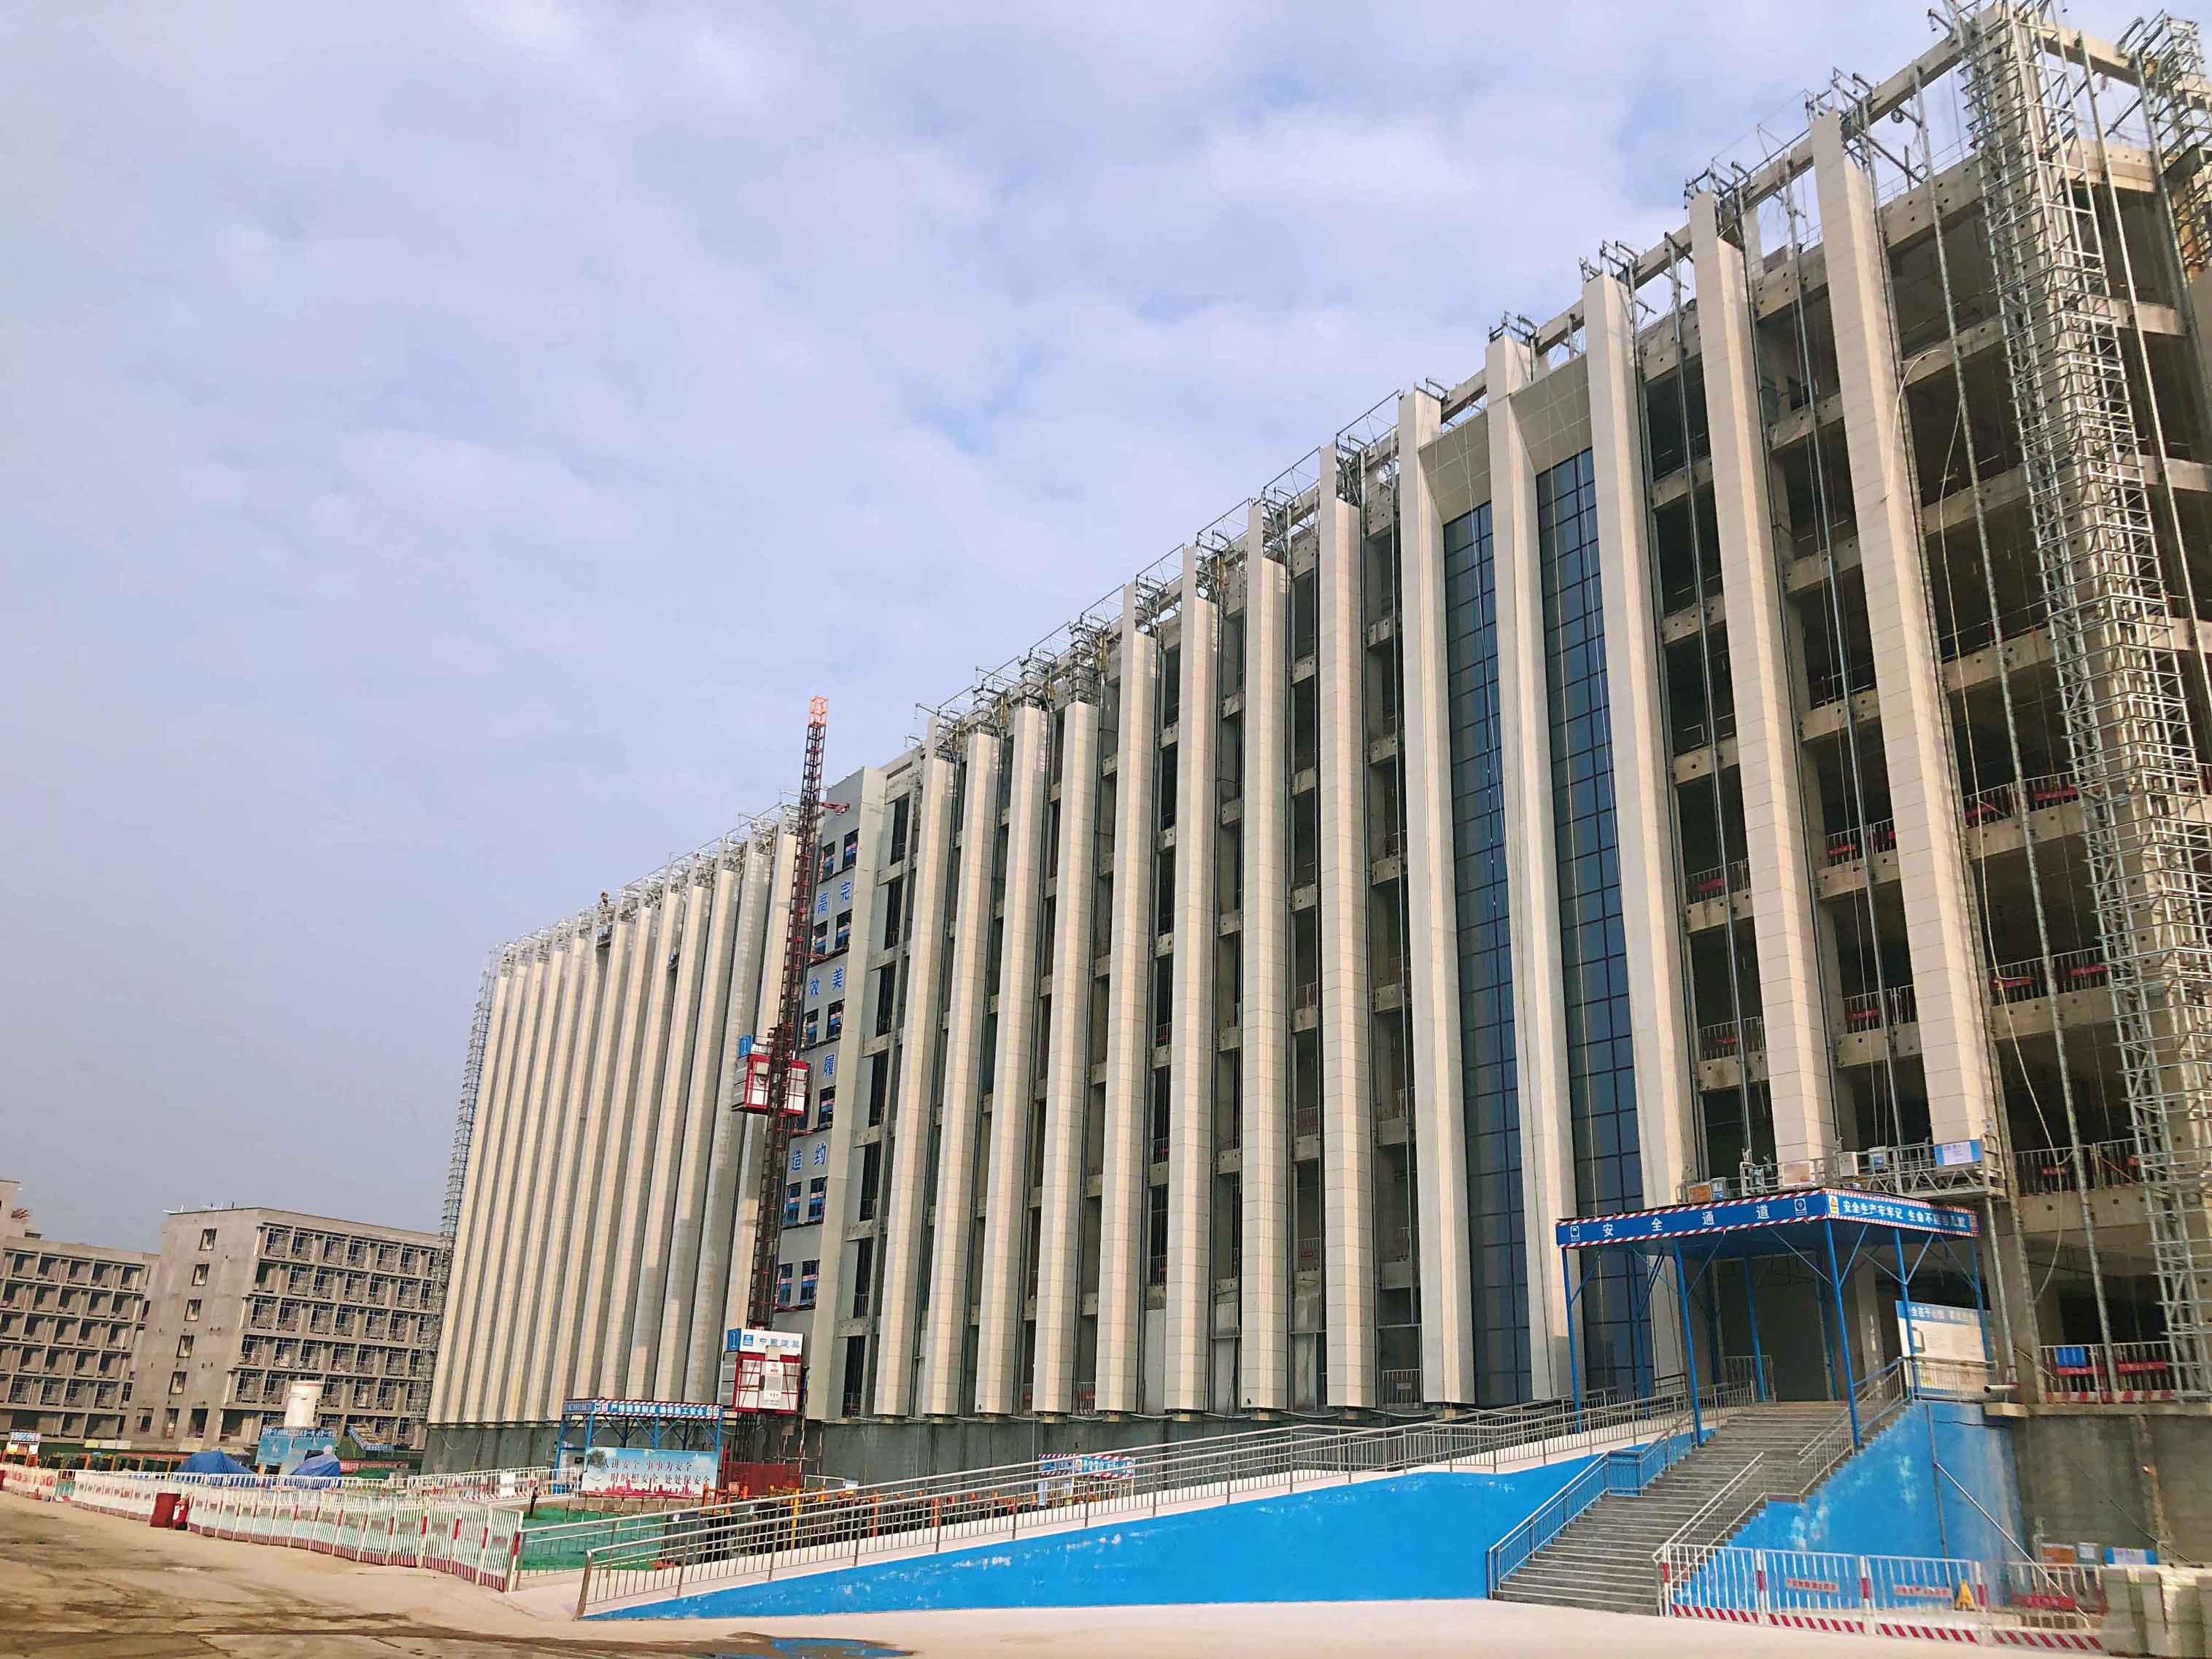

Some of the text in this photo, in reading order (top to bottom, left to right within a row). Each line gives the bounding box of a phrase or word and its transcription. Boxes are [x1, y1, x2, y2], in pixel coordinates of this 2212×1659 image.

[1602, 1204, 1771, 1237] 安全通道
[646, 1459, 692, 1472] 事事为安全
[611, 1472, 711, 1485] 时时想安全 处处保安全
